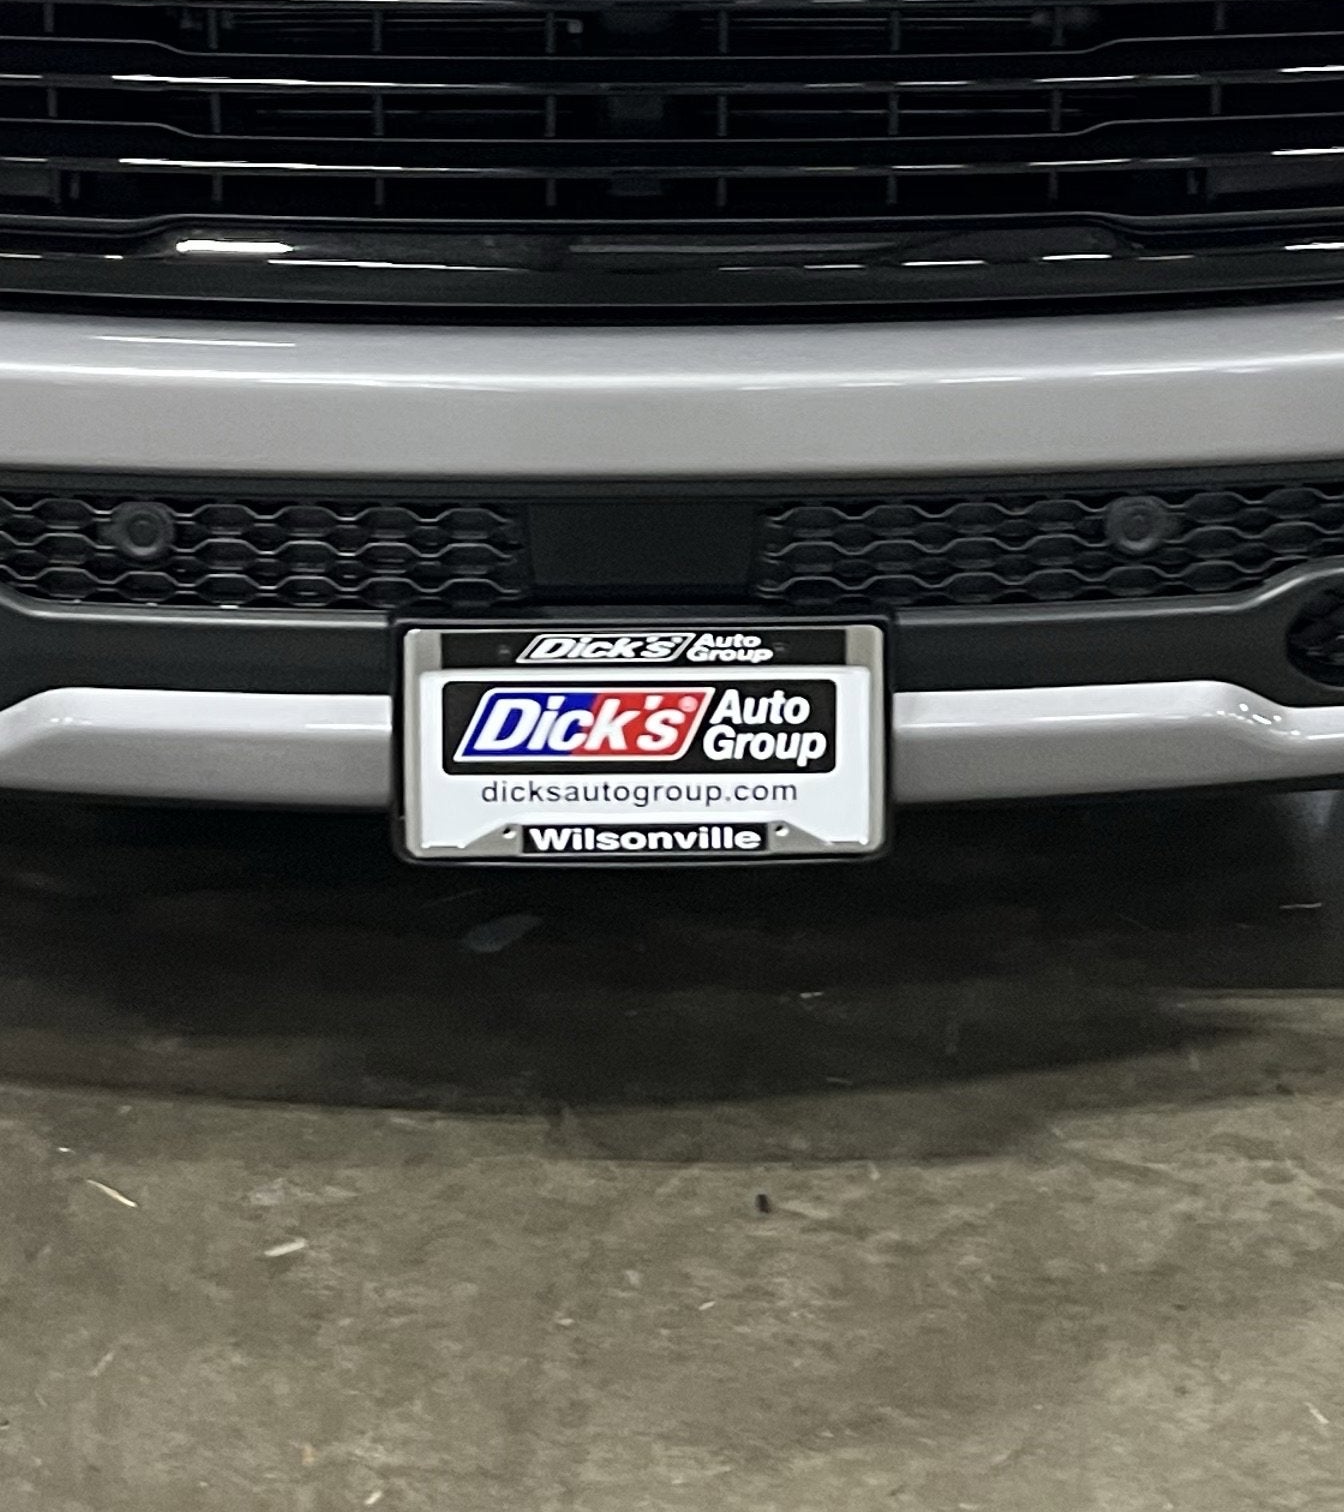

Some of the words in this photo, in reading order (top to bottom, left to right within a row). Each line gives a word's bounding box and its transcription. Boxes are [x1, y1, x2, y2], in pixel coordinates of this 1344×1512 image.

[692, 633, 762, 649] Auto
[687, 647, 774, 664] Group
[710, 689, 810, 725] Auto
[702, 724, 828, 767] Group
[481, 779, 798, 808] dicksautogroup.com
[528, 826, 762, 852] Wilsonville
